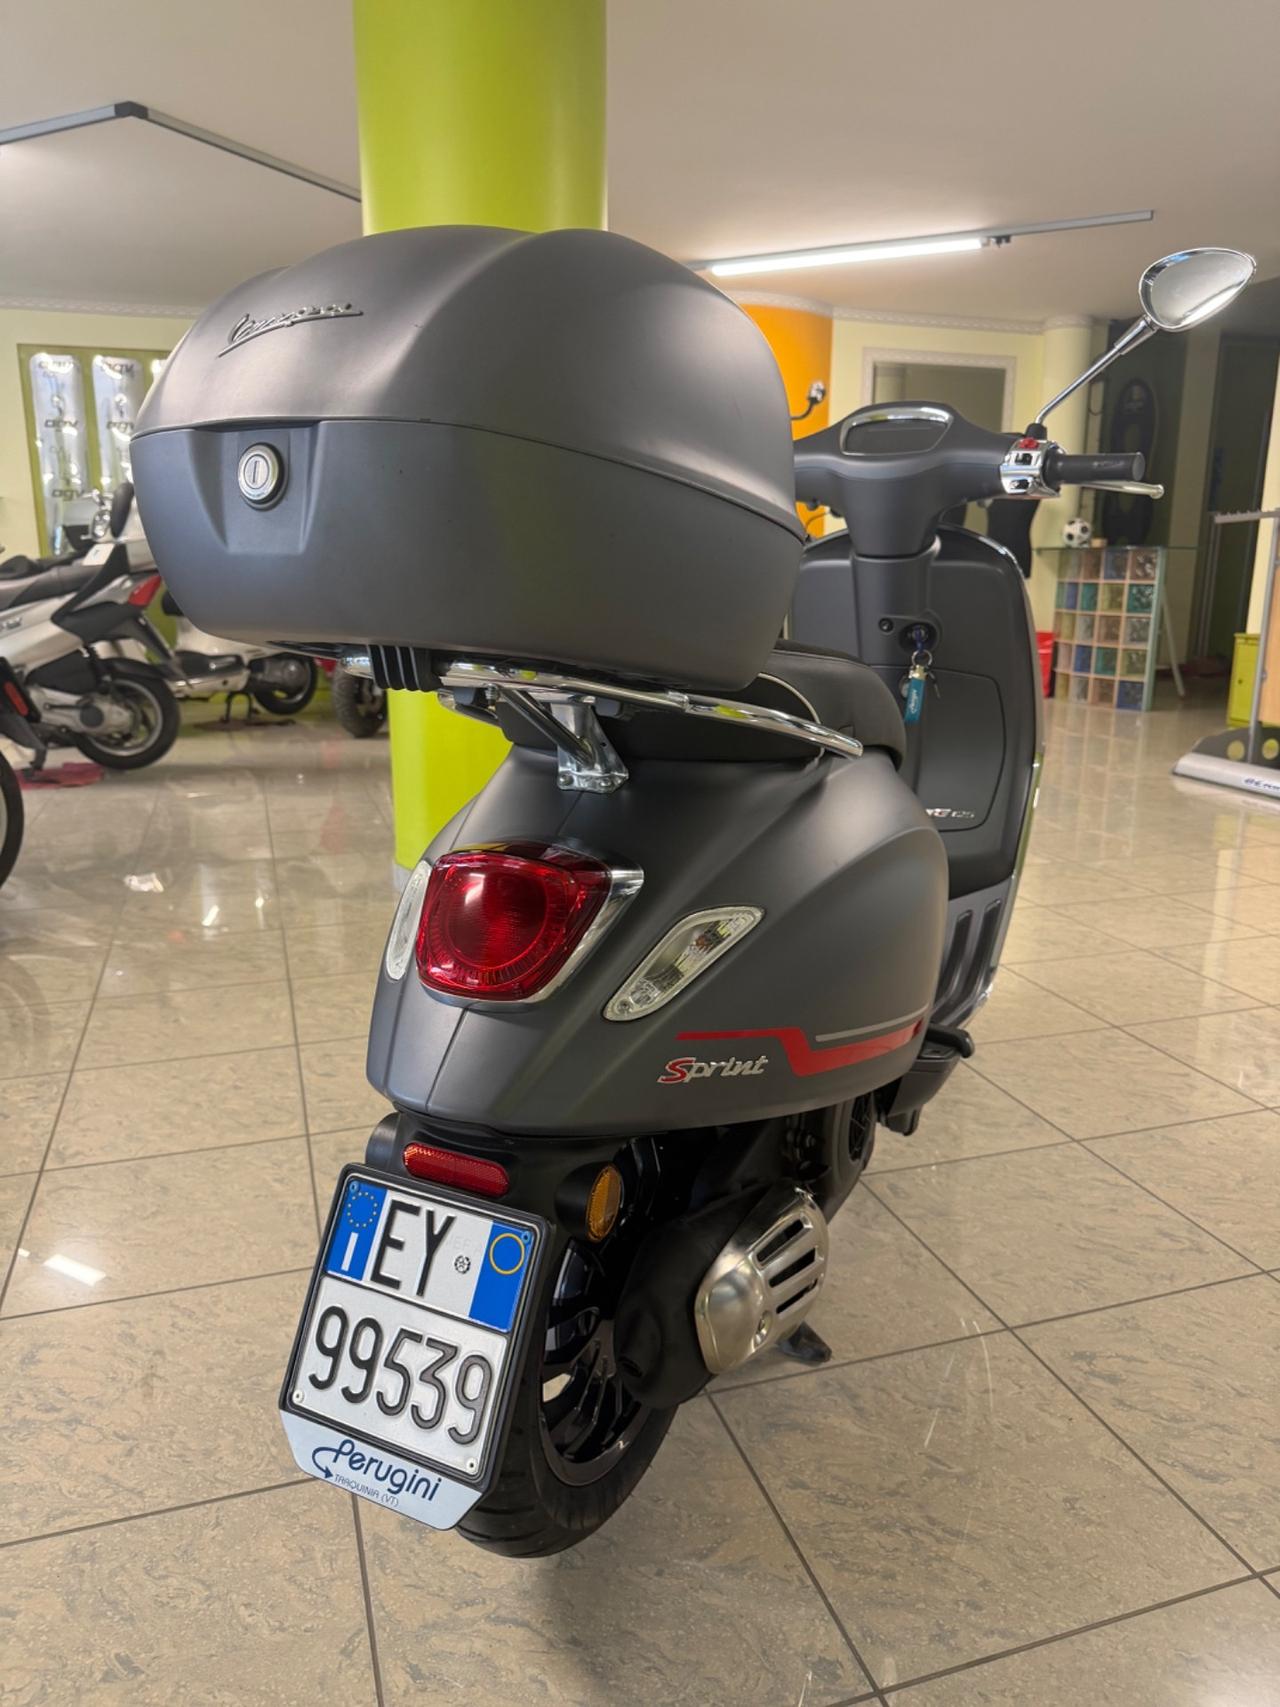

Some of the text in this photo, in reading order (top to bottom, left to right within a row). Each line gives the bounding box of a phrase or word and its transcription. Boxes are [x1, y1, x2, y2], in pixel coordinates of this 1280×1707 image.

[657, 1055, 769, 1084] Sprint
[370, 1199, 455, 1297] EY
[308, 1305, 493, 1446] 99539
[331, 1439, 442, 1501] Perugini
